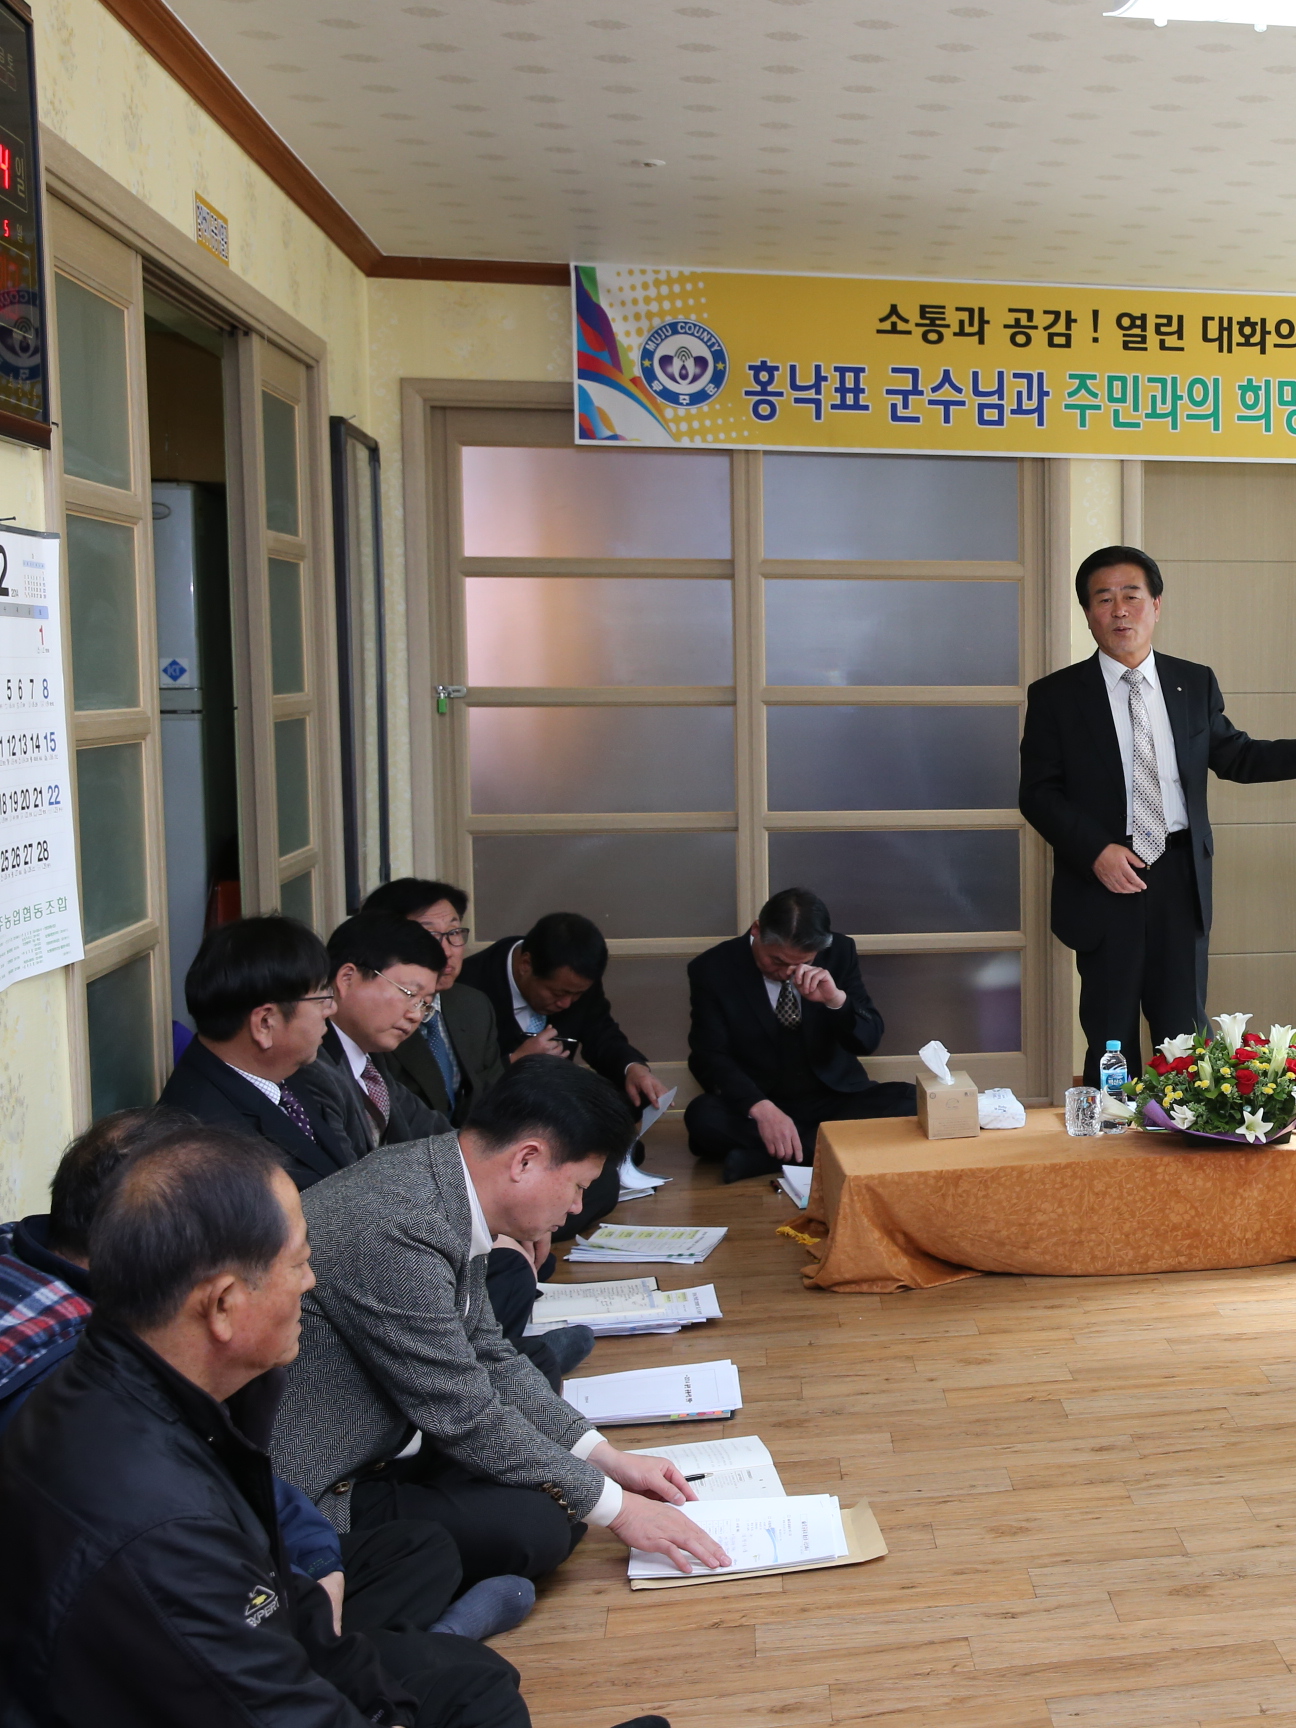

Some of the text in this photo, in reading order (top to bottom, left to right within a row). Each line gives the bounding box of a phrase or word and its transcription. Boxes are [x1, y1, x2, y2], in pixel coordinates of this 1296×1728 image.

[3, 219, 10, 237] 5
[645, 322, 721, 352] MUJU COUNTY
[876, 303, 991, 345] 소통과
[1003, 307, 1078, 349] 공감
[1115, 312, 1185, 352] 열린
[743, 359, 871, 422] 홍낙표
[884, 366, 1051, 428] 군수님과
[1063, 372, 1221, 433] 주민과의
[39, 624, 45, 645] 1
[6, 678, 49, 700] 5 6 7 8
[7, 734, 16, 757] 12
[18, 733, 27, 755] 13
[30, 732, 40, 754] 14
[43, 731, 56, 753] 15
[10, 790, 18, 812] 19
[20, 788, 30, 811] 20
[33, 786, 43, 808] 21
[48, 784, 61, 806] 22
[1, 849, 9, 872] 25
[11, 846, 21, 869] 26
[23, 843, 33, 866] 27
[36, 840, 49, 862] 28
[246, 1595, 280, 1627] EXPERT
